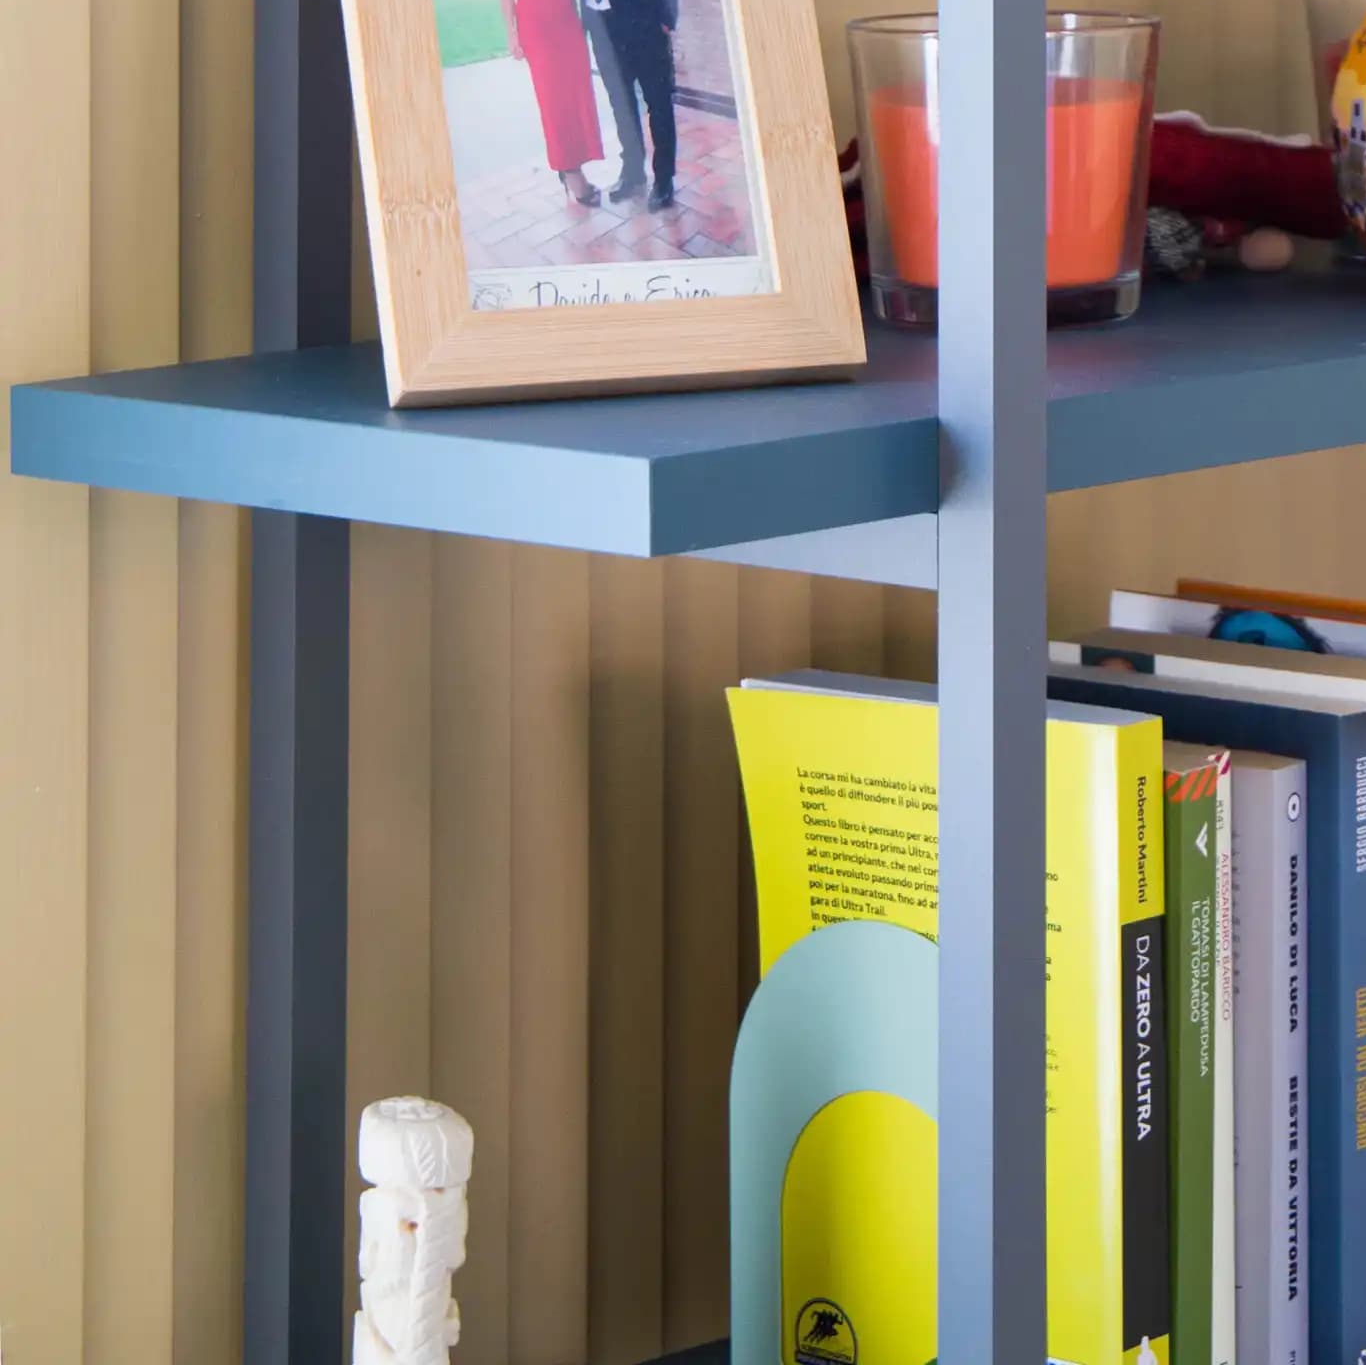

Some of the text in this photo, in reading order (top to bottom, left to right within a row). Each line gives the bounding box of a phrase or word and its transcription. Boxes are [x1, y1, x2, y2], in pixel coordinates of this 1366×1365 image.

[797, 767, 937, 795] La corsa mi ha cambiato la vita
[802, 800, 827, 811] sport.
[807, 785, 836, 797] quello
[837, 788, 847, 797] di
[848, 789, 897, 805] diffondere
[906, 797, 920, 809] più
[803, 814, 837, 828] Questo
[838, 819, 860, 831] libro
[868, 825, 905, 838] pensato
[906, 831, 921, 842] per
[1136, 776, 1147, 904] Roberto Martini
[805, 832, 933, 859] correre la vostra prima Ultra,
[807, 847, 818, 857] ad
[819, 850, 831, 858] un
[832, 851, 889, 868] principiante,
[891, 860, 906, 871] che
[908, 863, 921, 873] nel
[808, 863, 834, 875] atleta
[836, 867, 870, 880] evoluto
[872, 872, 913, 887] passando
[809, 879, 823, 889] poi
[825, 883, 839, 892] per
[841, 883, 850, 894] la
[851, 886, 896, 902] maratona,
[897, 893, 914, 904] fino
[916, 897, 928, 908] ad
[810, 896, 887, 916] gara di Ultra Trail.
[1221, 853, 1232, 1021] ALESSANDRO BARICCO
[1289, 855, 1298, 1033] DANILO DI LUCA
[1190, 900, 1200, 1023] IL GATTOPARDO
[1200, 897, 1211, 1077] TOMASI DI LAMPEDUSA
[1136, 935, 1152, 1141] DA ZERO A ULTRA
[1288, 1076, 1298, 1301] BESTIE DA VITTORIA
